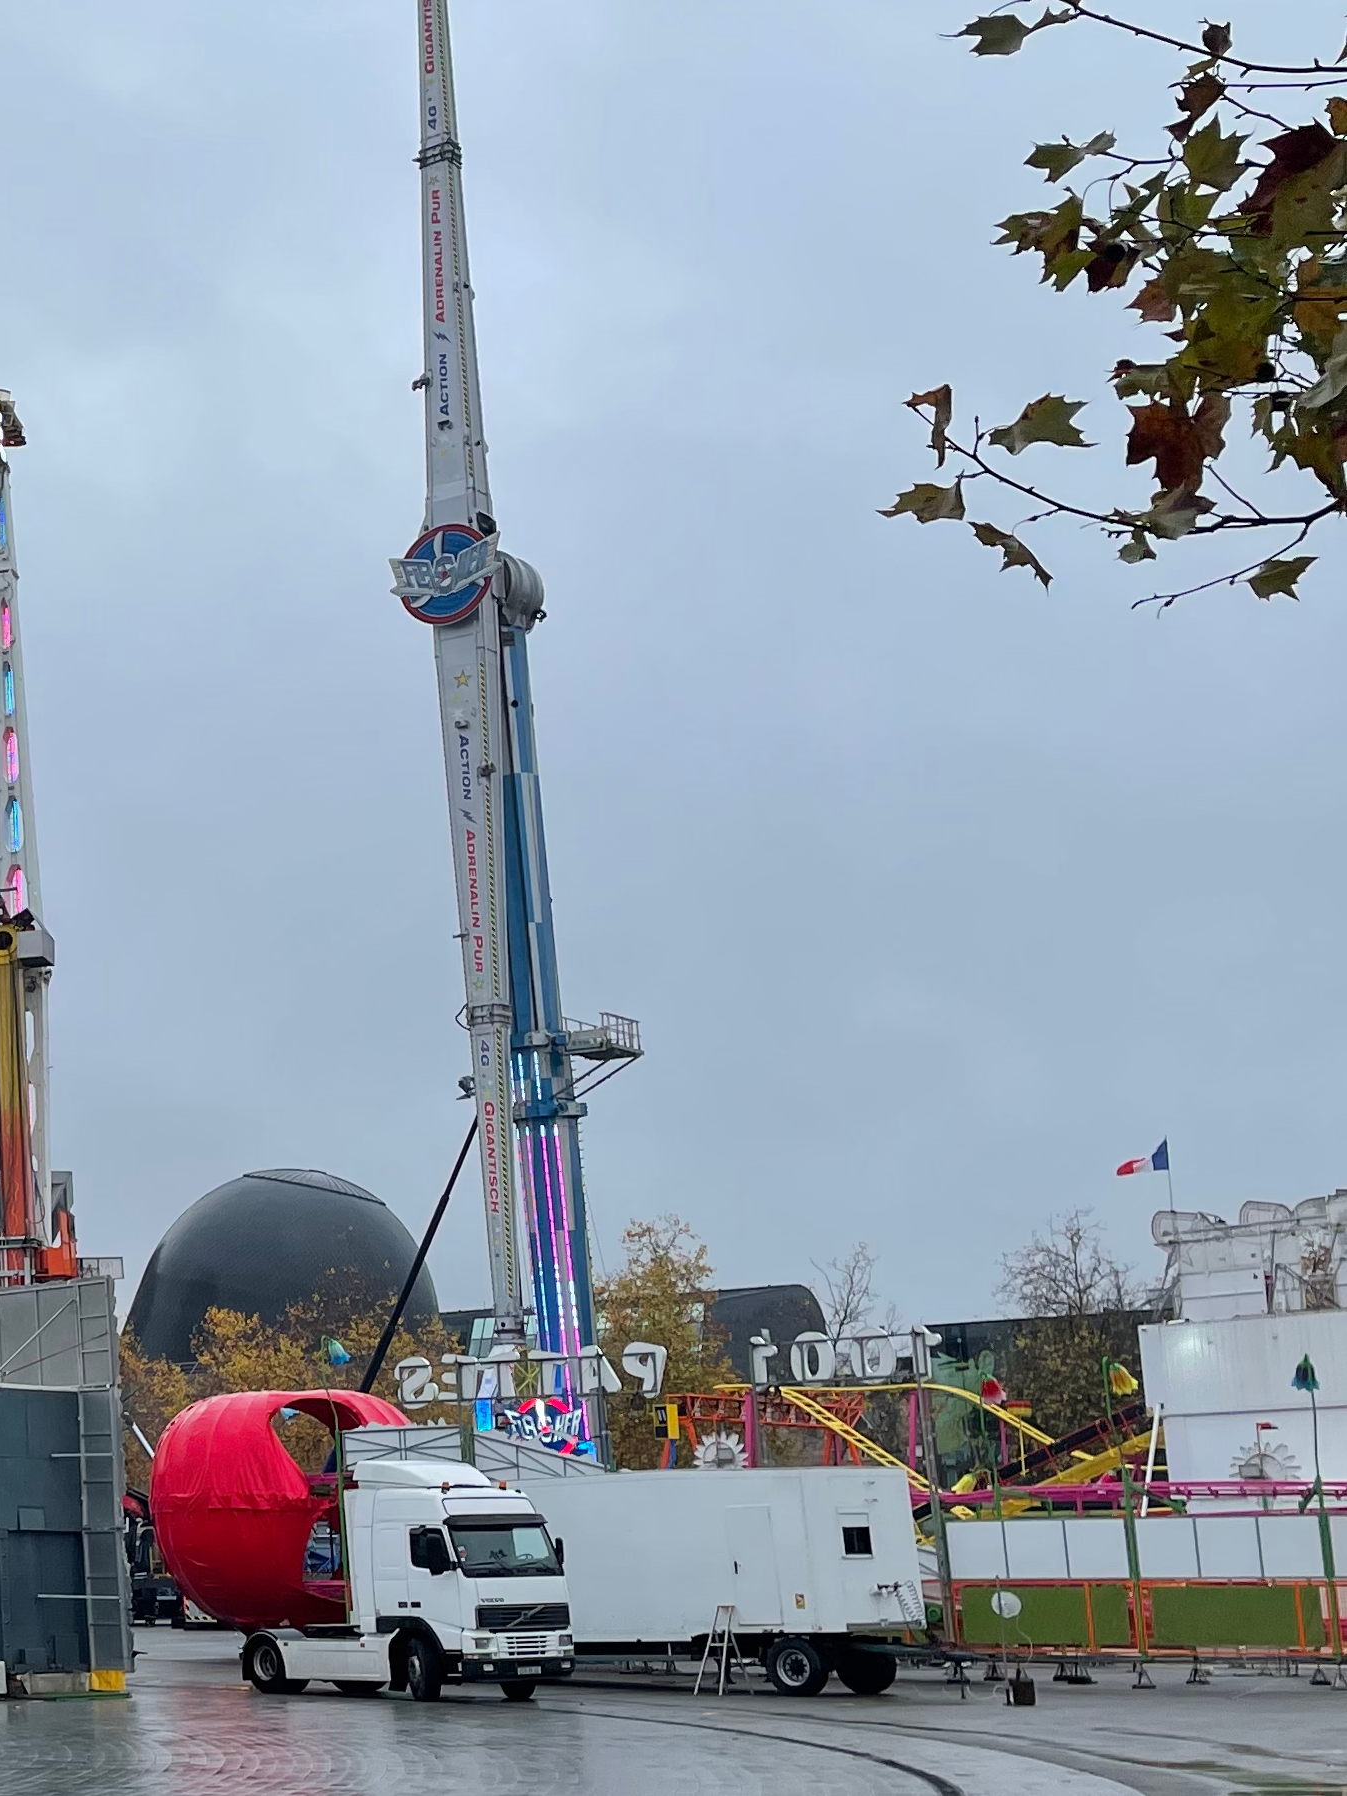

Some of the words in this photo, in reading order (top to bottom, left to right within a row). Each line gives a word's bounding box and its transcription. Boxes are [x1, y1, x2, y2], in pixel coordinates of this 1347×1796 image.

[431, 189, 442, 225] PUR
[430, 230, 446, 323] ADRENALIN
[437, 353, 450, 416] ACTION
[458, 734, 472, 800] ACTION
[465, 828, 481, 928] ADRENALIN
[472, 935, 484, 974] PUR
[484, 1101, 500, 1214] GIGANTISCH
